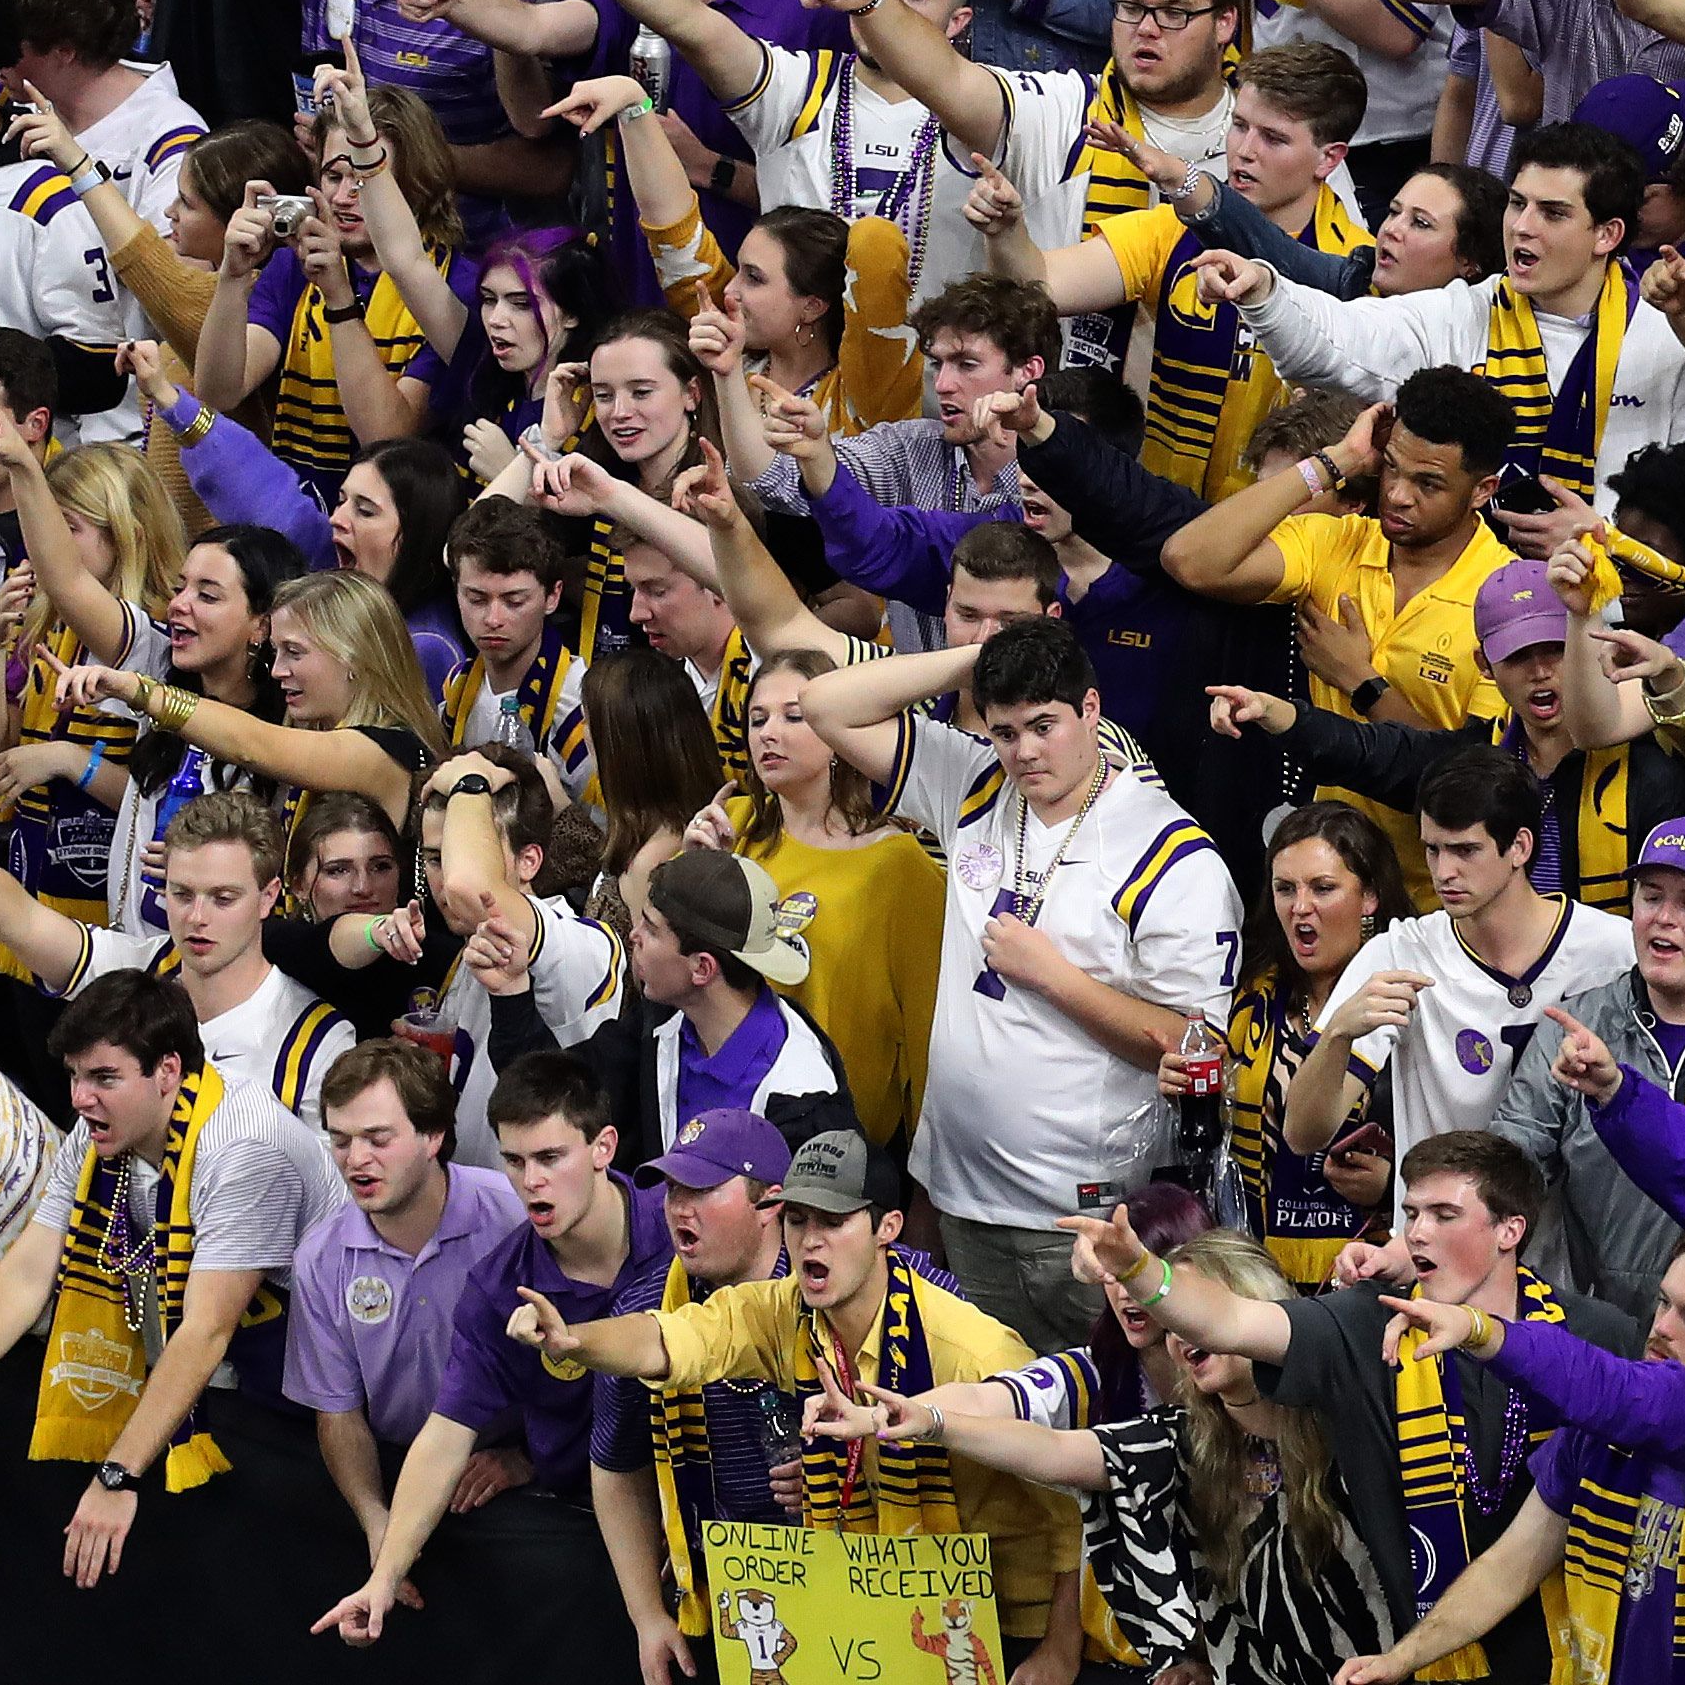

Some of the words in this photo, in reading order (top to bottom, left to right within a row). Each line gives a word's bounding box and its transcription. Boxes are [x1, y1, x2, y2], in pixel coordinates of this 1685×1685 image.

[396, 49, 428, 67] LSU
[865, 144, 898, 157] LSU
[84, 247, 114, 304] 3
[1108, 630, 1151, 647] LSU
[1419, 667, 1448, 684] LSU
[1216, 931, 1238, 987] 7
[708, 1521, 816, 1557] ONLINE
[842, 1535, 920, 1564] WHAT
[930, 1536, 990, 1566] YOU
[723, 1555, 806, 1592] ORDER
[849, 1569, 996, 1600] RECEIVED
[758, 1636, 767, 1659] 1
[830, 1636, 881, 1680] VS
